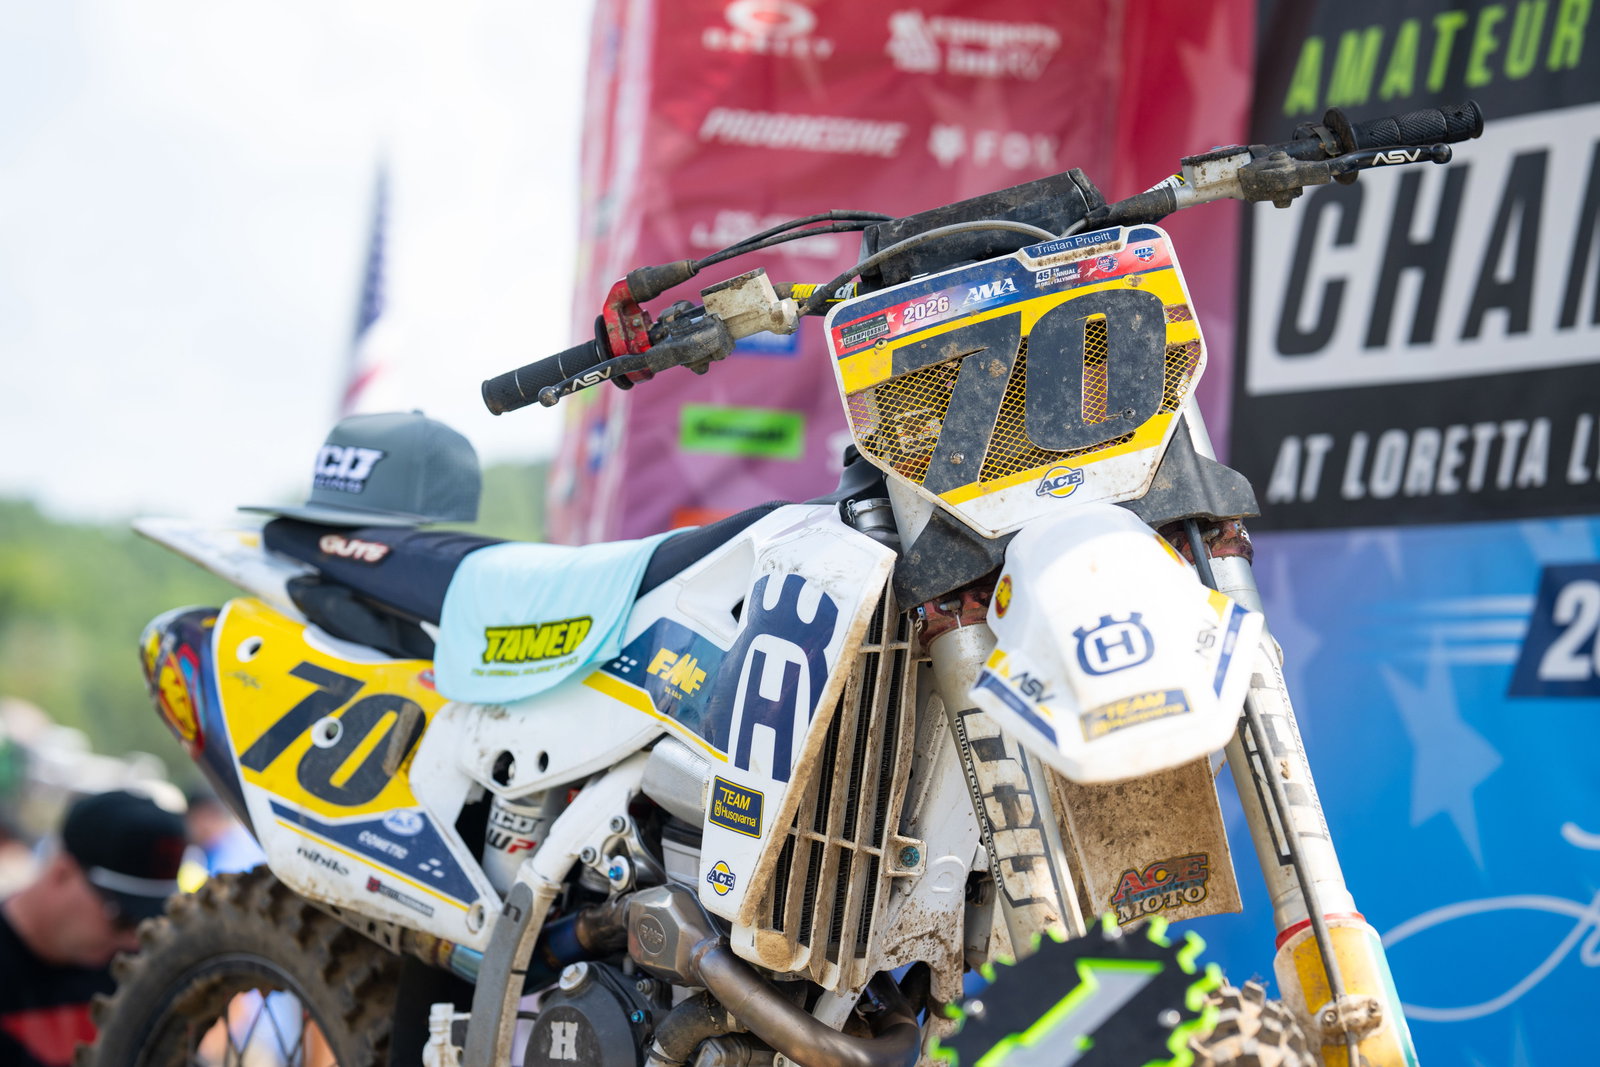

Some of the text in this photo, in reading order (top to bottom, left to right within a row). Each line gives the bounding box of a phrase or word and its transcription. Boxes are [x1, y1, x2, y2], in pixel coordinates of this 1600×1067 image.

[1283, 0, 1591, 117] AMATEUR
[1372, 148, 1421, 166] ASV
[1035, 232, 1111, 255] Tristan Prueitt
[963, 278, 1018, 304] AMA
[903, 298, 950, 325] 2026
[844, 324, 888, 344] CHAMPIONSHIP
[572, 367, 612, 391] ASV
[890, 288, 1166, 494] 70
[1266, 413, 1600, 503] AT LORETTA L
[1037, 469, 1083, 497] ACE
[483, 616, 592, 664] TAMER
[1538, 579, 1600, 681] 2
[646, 647, 707, 695] FMF
[1011, 672, 1056, 703] ASV
[239, 660, 426, 808] 70
[719, 786, 751, 811] TEAM
[721, 805, 757, 828] Husqvarna
[708, 869, 734, 888] ACE
[1112, 855, 1208, 905] ACE
[1117, 885, 1207, 926] MOTO
